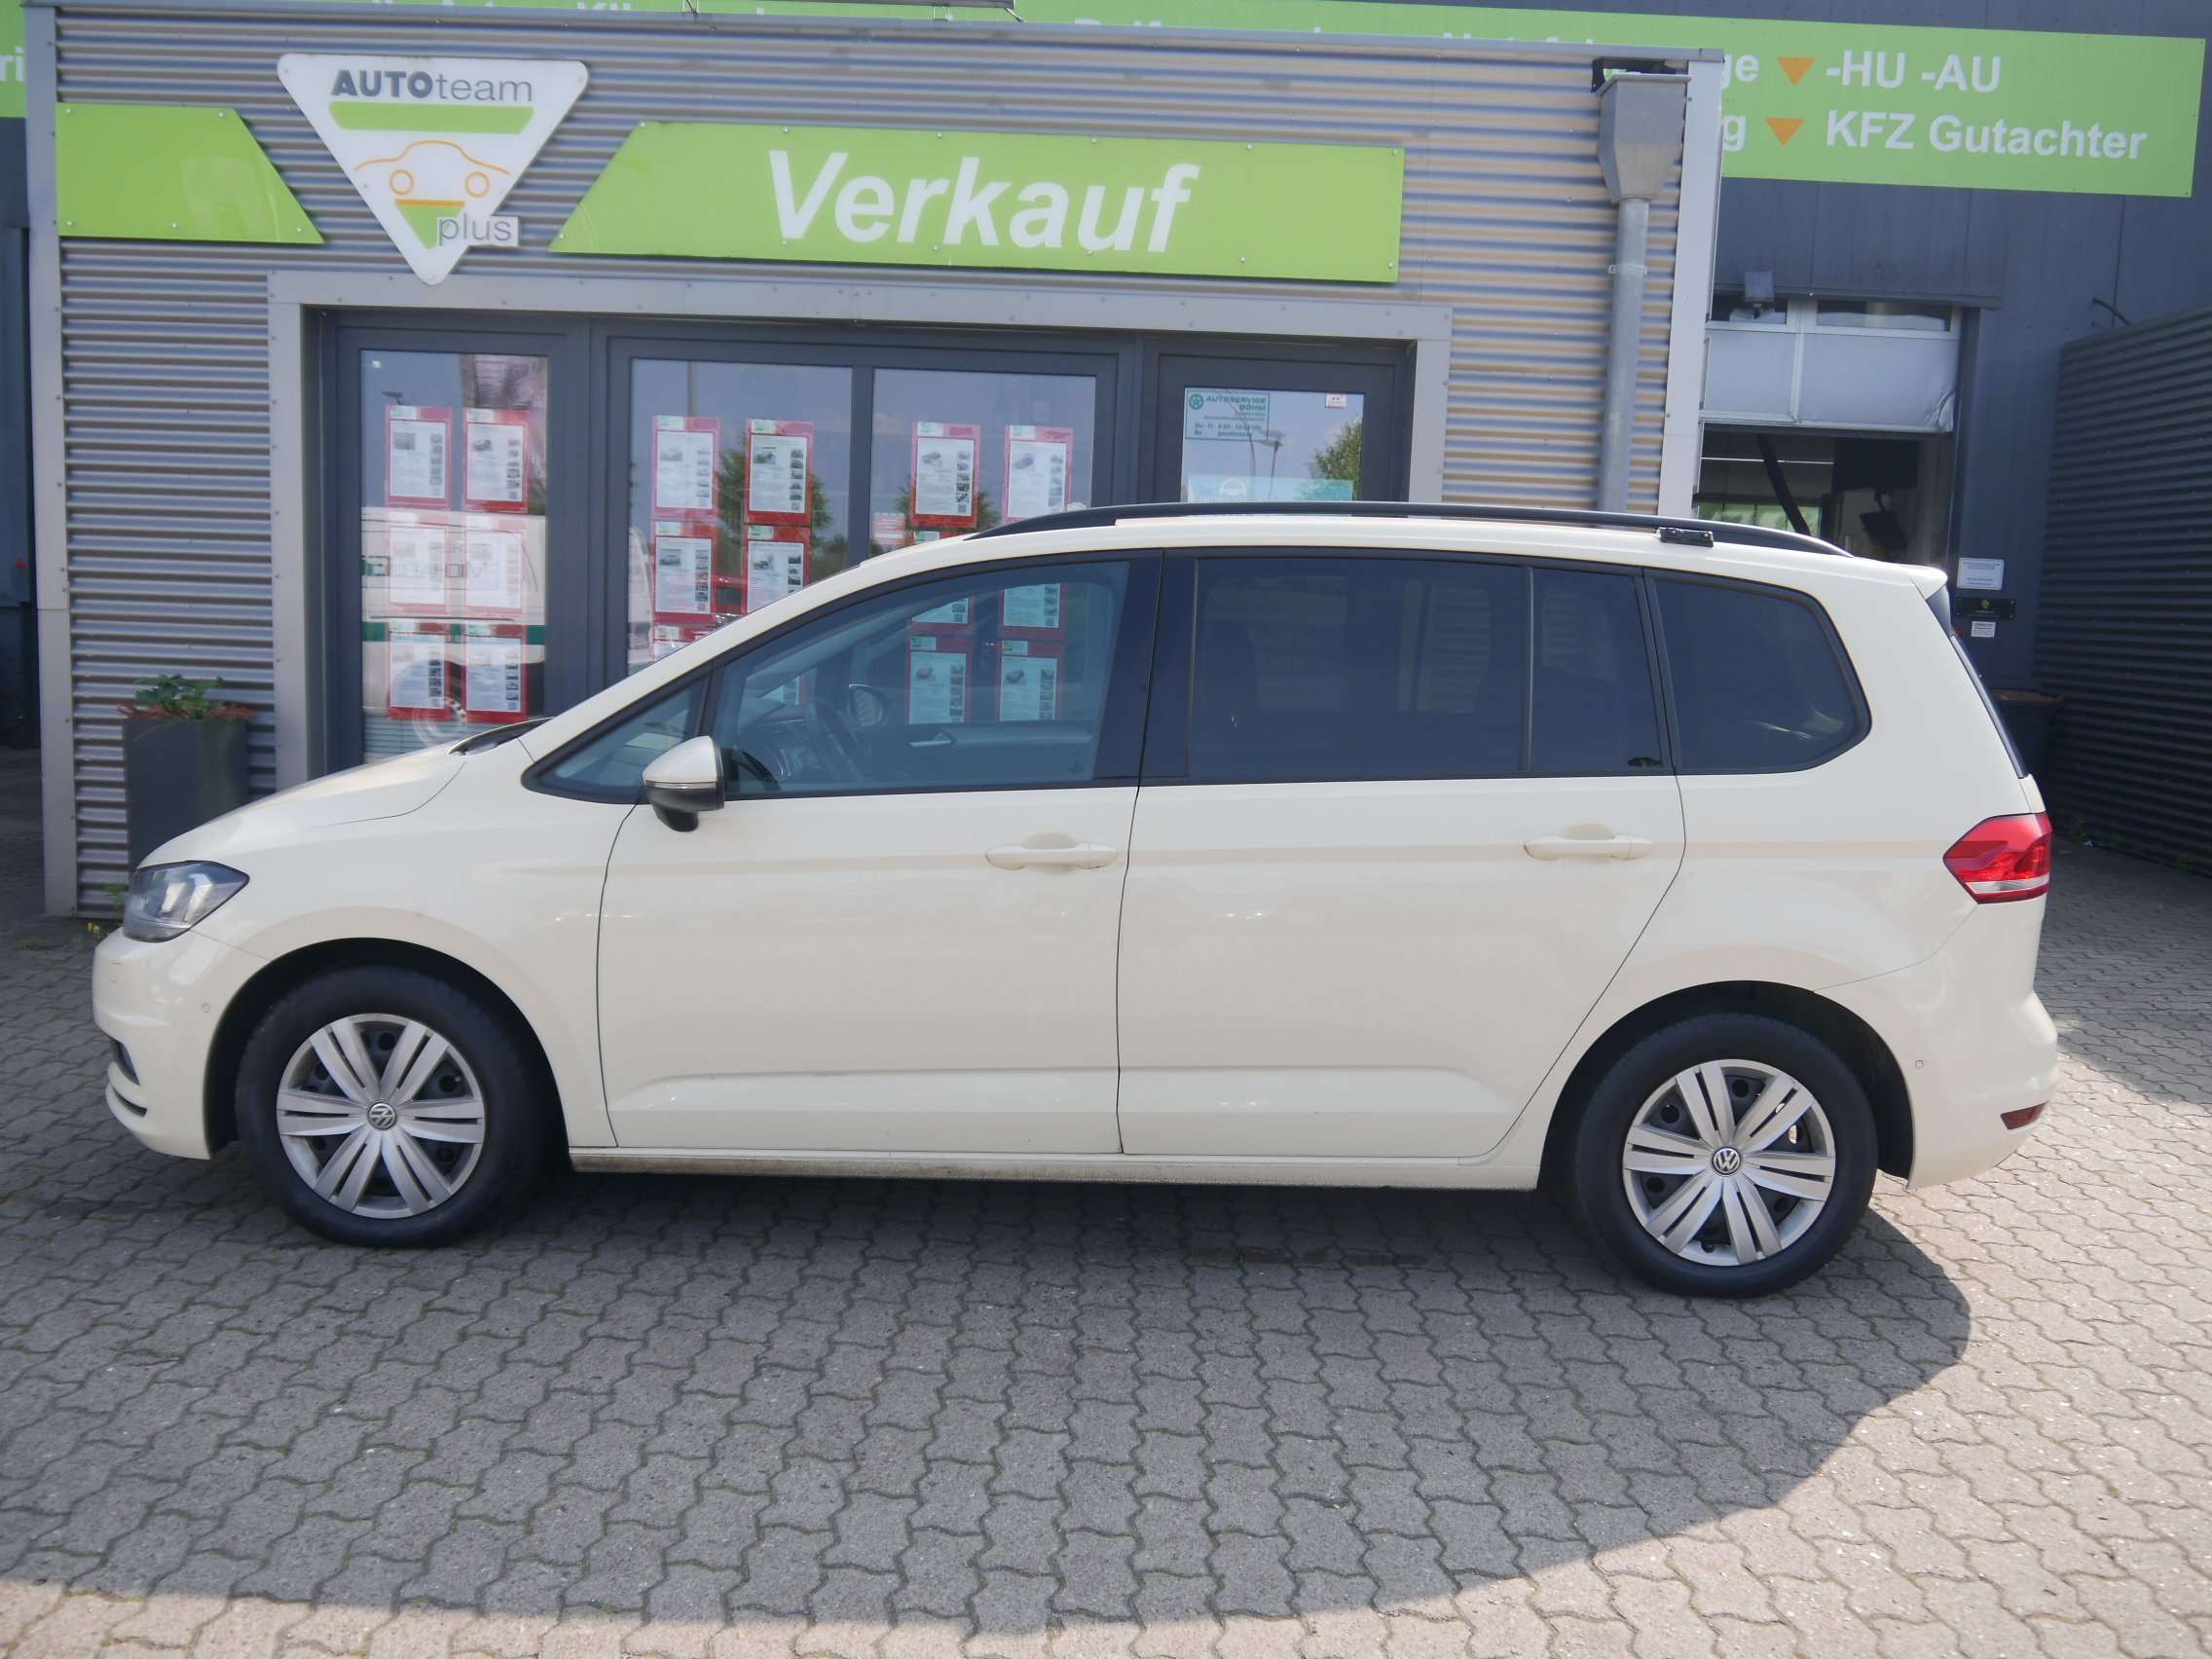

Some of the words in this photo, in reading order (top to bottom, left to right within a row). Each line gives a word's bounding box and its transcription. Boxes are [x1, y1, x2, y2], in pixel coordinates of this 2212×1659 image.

[331, 69, 534, 101] AUTOteam
[1826, 50, 1905, 89] -HU
[1921, 54, 2003, 92] -AU
[1826, 109, 1916, 150] KFZ
[1929, 114, 2148, 160] Gutachter
[768, 150, 1200, 253] Verkauf
[438, 212, 512, 246] plus
